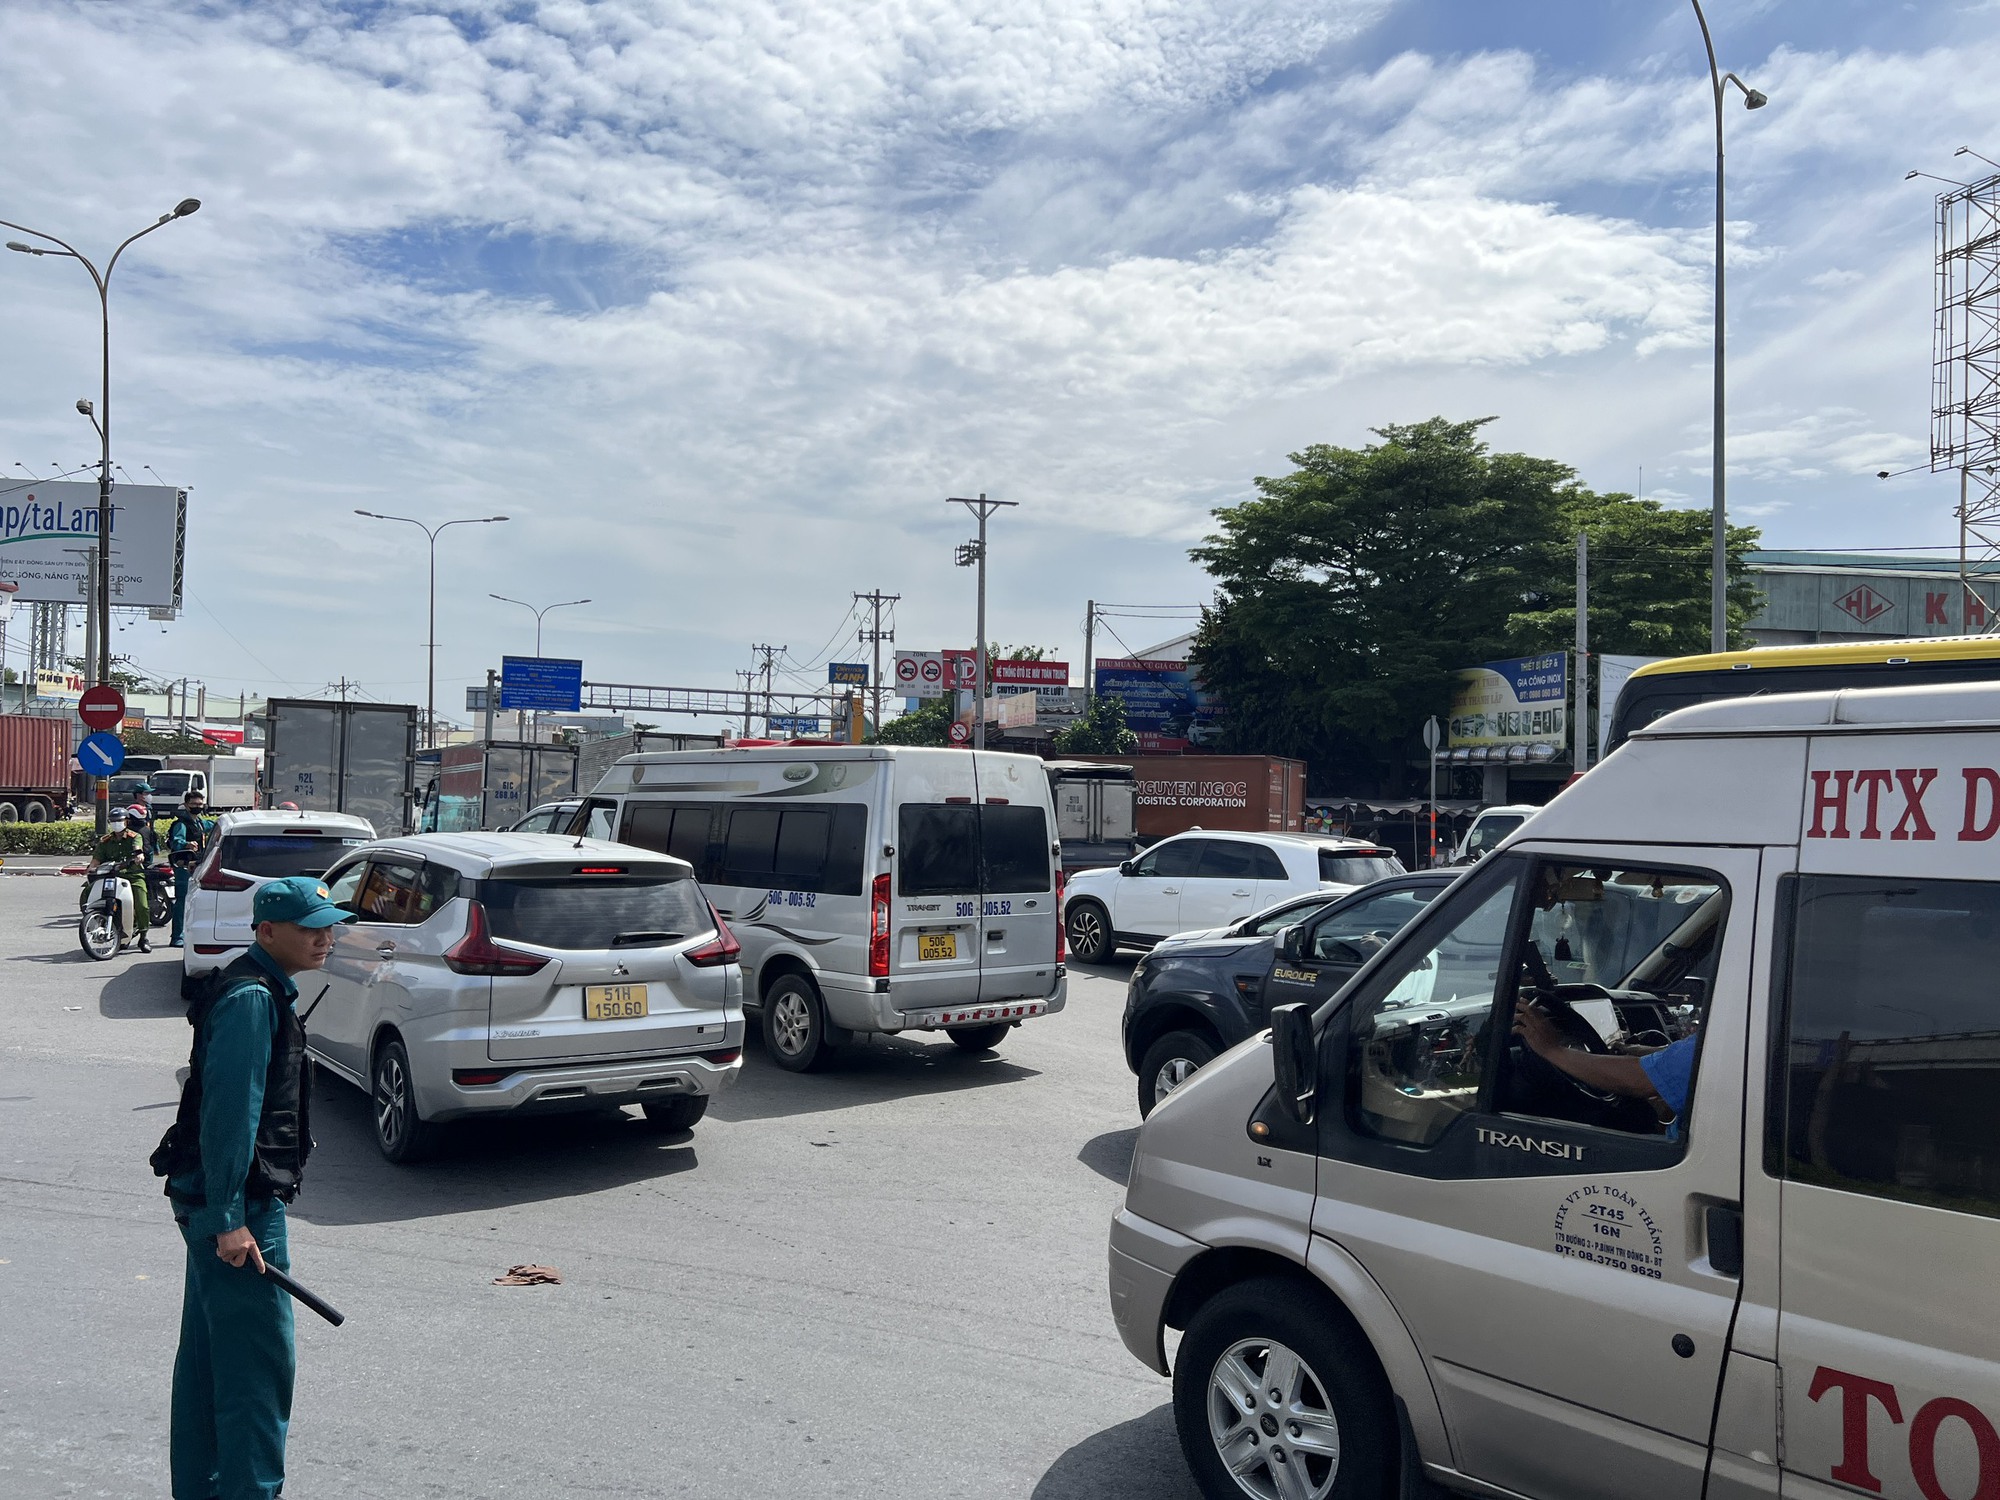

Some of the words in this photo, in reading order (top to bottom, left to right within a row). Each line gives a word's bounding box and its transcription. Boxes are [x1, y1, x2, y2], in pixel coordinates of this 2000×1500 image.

[1155, 661, 1167, 669] GIÁ
[833, 673, 865, 681] XANH
[1517, 678, 1528, 688] GIA
[1547, 673, 1561, 683] INOX
[1136, 781, 1196, 796] NGUYEN
[1199, 782, 1247, 797] NGOC
[1180, 797, 1246, 807] CORPORATION
[1807, 768, 1938, 841] HTX
[768, 890, 783, 906] 50G
[788, 892, 816, 908] 005.52
[956, 902, 973, 917] 50G
[929, 937, 946, 947] 50G
[923, 948, 953, 959] 005.52
[1274, 968, 1317, 982] EUROLIFE
[604, 987, 631, 1001] 51H
[595, 1002, 642, 1018] 150.60
[1475, 1127, 1588, 1161] TRANSIT
[1555, 1204, 1569, 1230] HTX
[1565, 1190, 1581, 1205] VT
[1583, 1185, 1599, 1196] DL
[1589, 1204, 1625, 1221] 2T45
[1593, 1223, 1621, 1239] 16N
[1555, 1243, 1575, 1256] ĐT:
[1578, 1250, 1627, 1270] 08.3750
[1630, 1264, 1662, 1279] 9629
